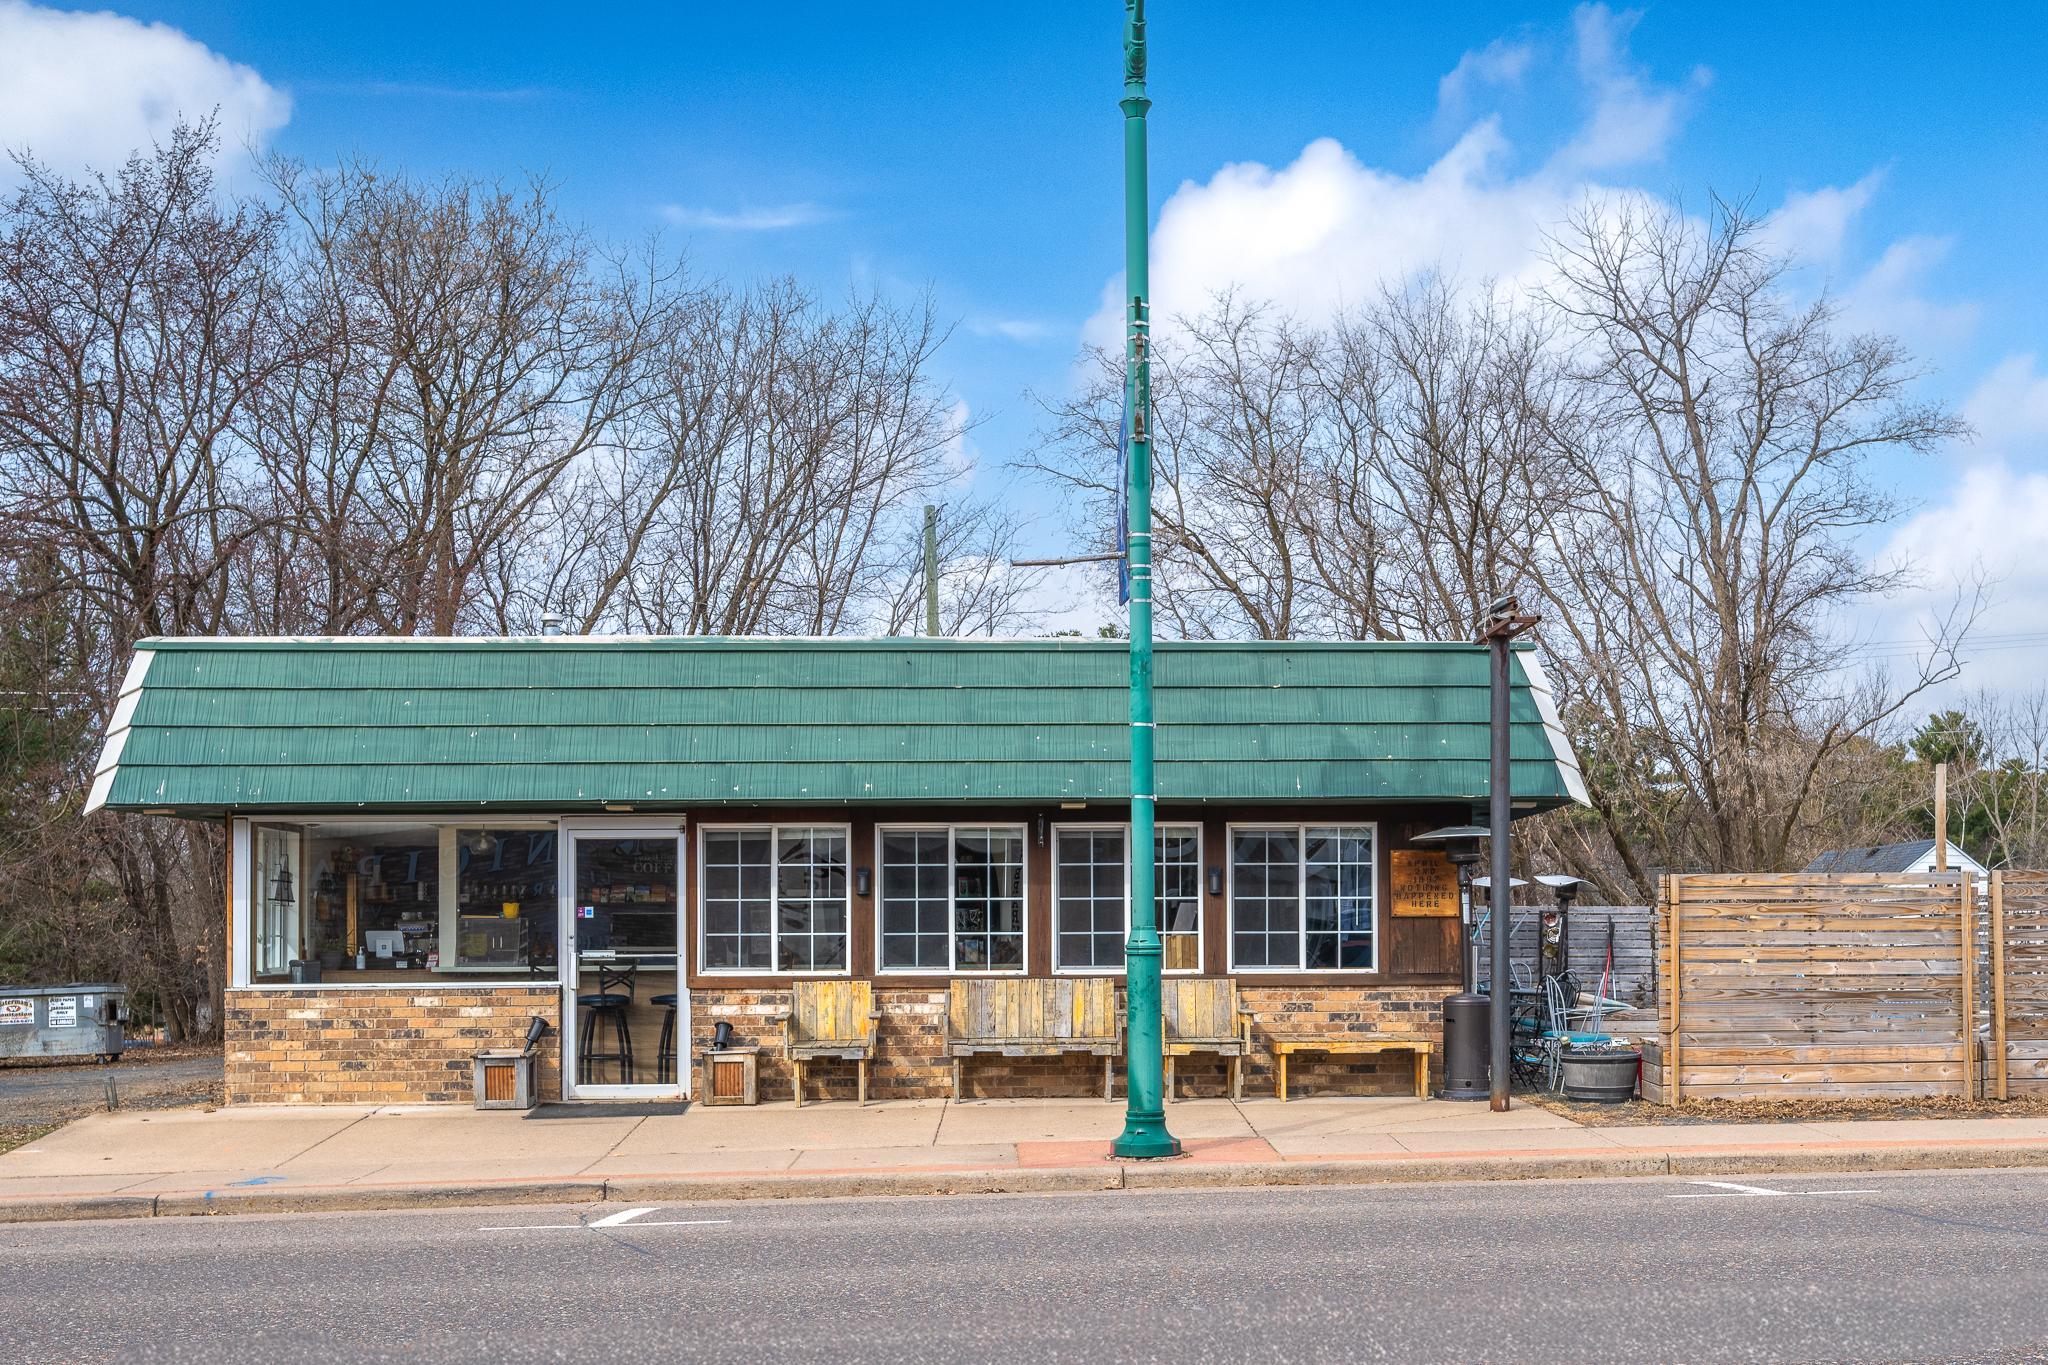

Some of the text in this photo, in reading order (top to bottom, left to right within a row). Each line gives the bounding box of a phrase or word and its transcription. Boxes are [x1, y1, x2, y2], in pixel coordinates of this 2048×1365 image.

[1400, 884, 1448, 892] NOTHING
[1396, 892, 1454, 900] HAPPENED
[1411, 900, 1440, 908] HERE
